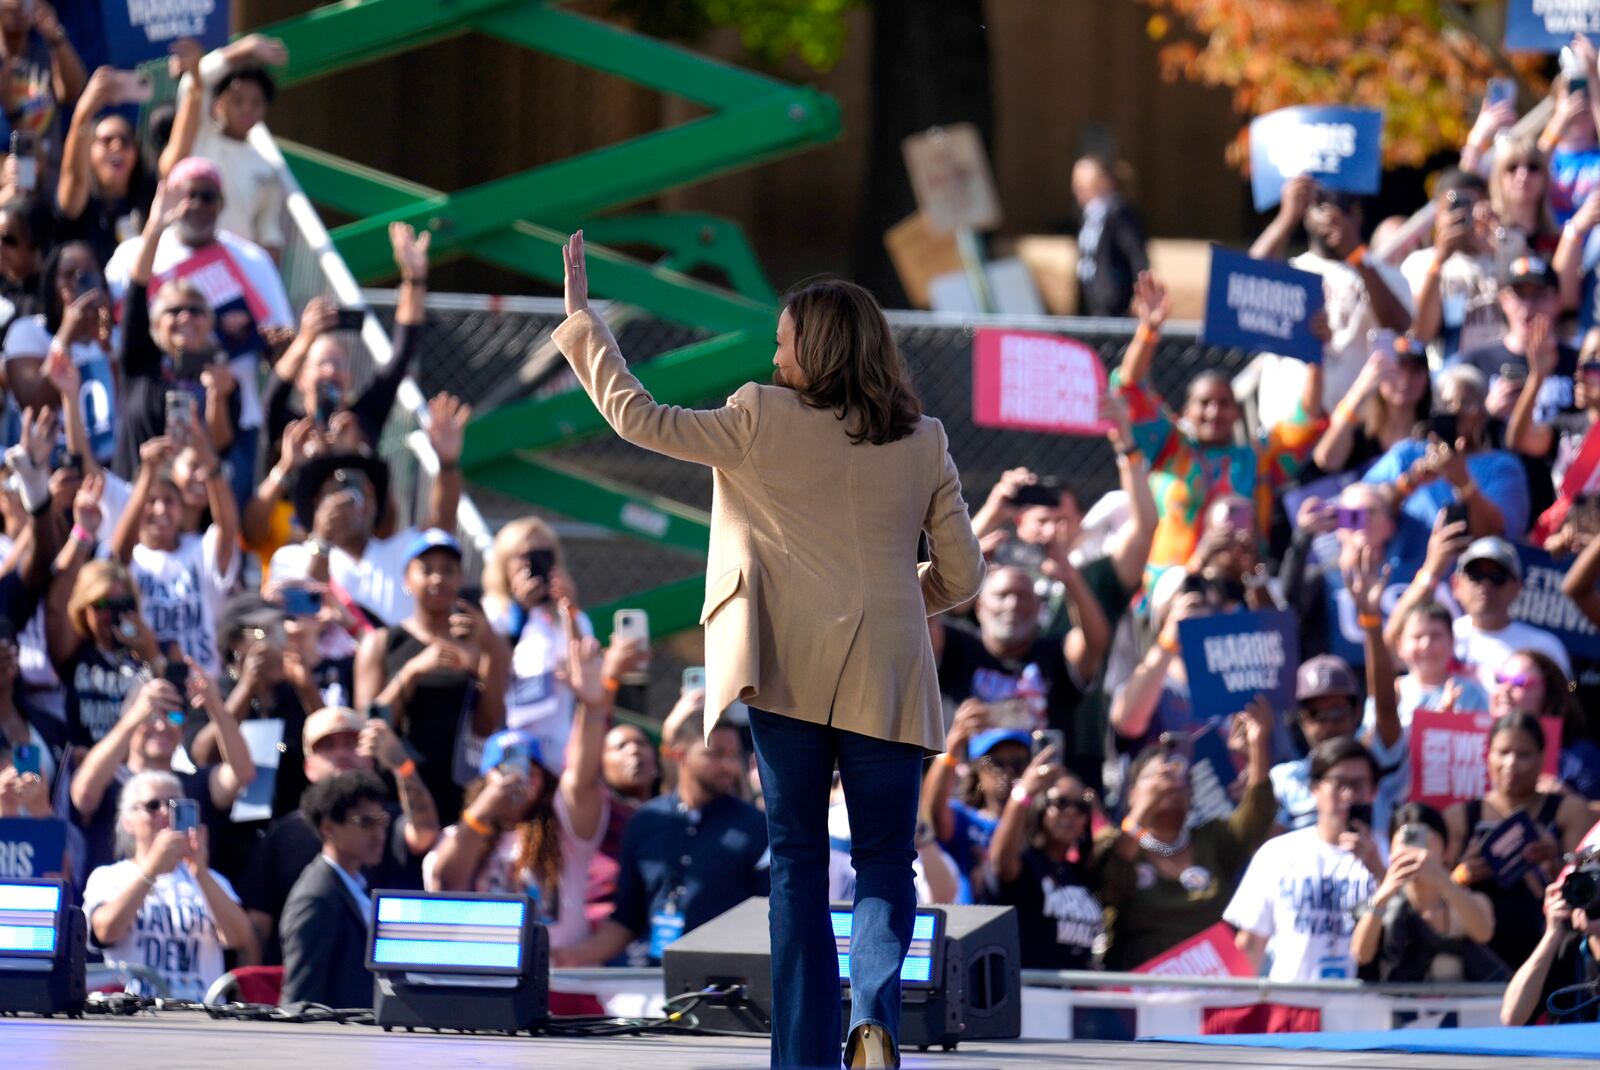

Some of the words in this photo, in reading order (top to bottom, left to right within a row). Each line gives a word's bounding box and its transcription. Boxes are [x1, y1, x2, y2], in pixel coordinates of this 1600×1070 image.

[1227, 272, 1306, 322] HARRIS
[1237, 307, 1293, 340] WALZ
[1203, 631, 1285, 674] HARRIS
[1222, 667, 1279, 693] WALZ
